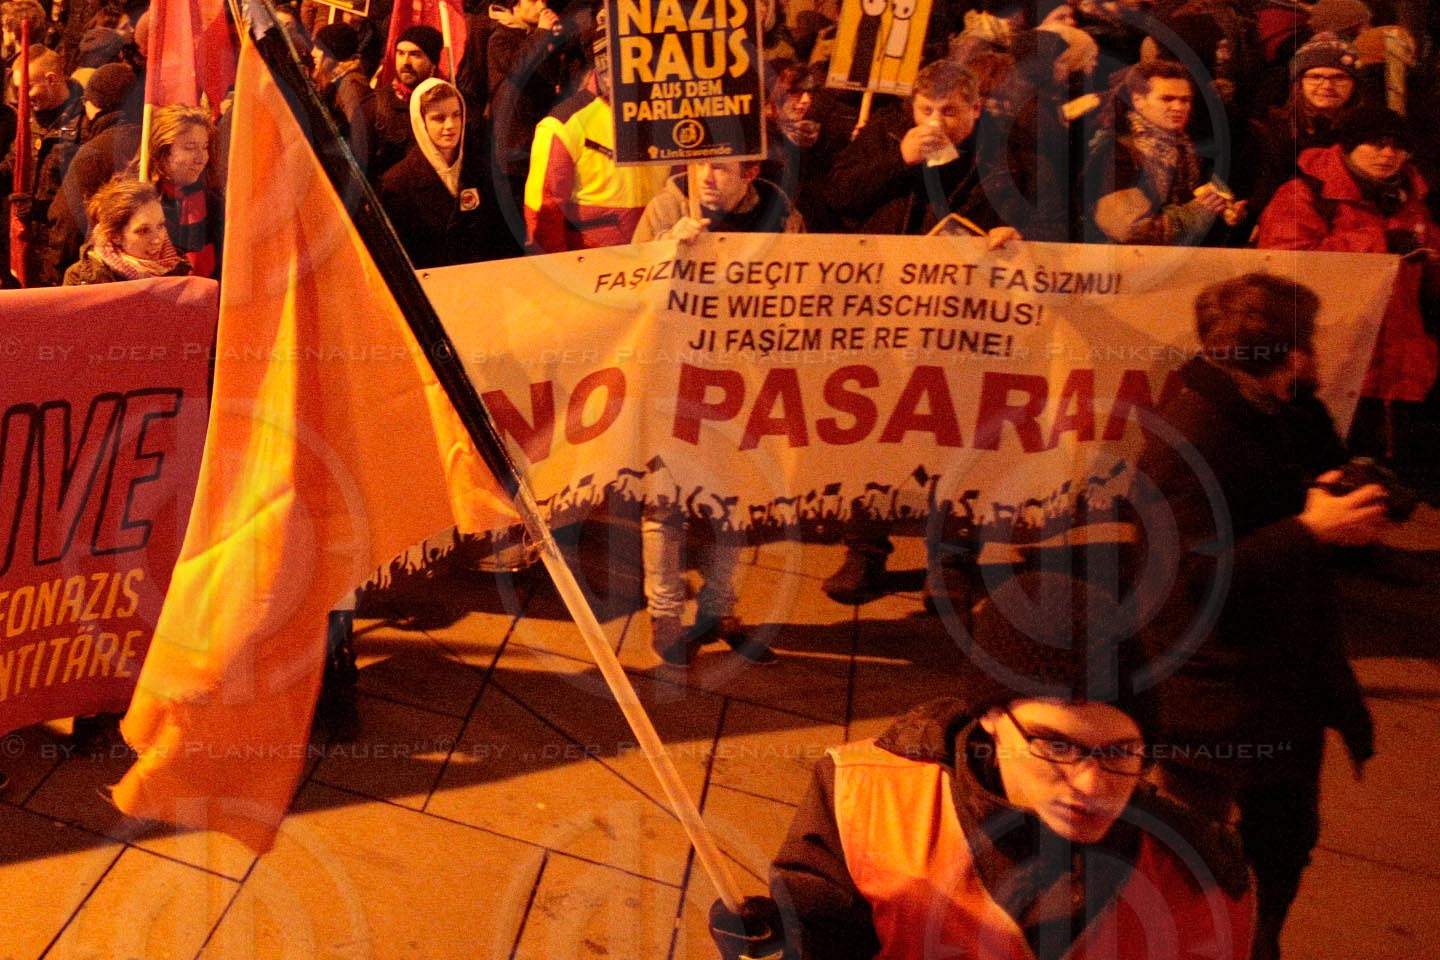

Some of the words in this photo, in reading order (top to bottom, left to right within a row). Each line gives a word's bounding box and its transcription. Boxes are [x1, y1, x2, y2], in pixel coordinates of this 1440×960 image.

[620, 27, 750, 84] RAUS
[650, 80, 682, 100] AUS
[686, 79, 723, 96] DEM
[623, 94, 753, 122] PARLAMENT
[594, 259, 716, 293] FAŞIZME
[726, 261, 809, 290] GEÇIT
[819, 262, 884, 284] YOK!
[900, 263, 978, 286] SMRT
[667, 290, 719, 318] NIE
[728, 295, 833, 318] WIEDER
[843, 294, 1044, 326] FASCHISMUS!
[689, 329, 716, 352] JI
[831, 328, 865, 350] RE
[874, 327, 908, 349] RE
[919, 328, 1013, 357] TUNE!
[482, 366, 626, 464] NO
[671, 364, 1182, 454] PASARAN
